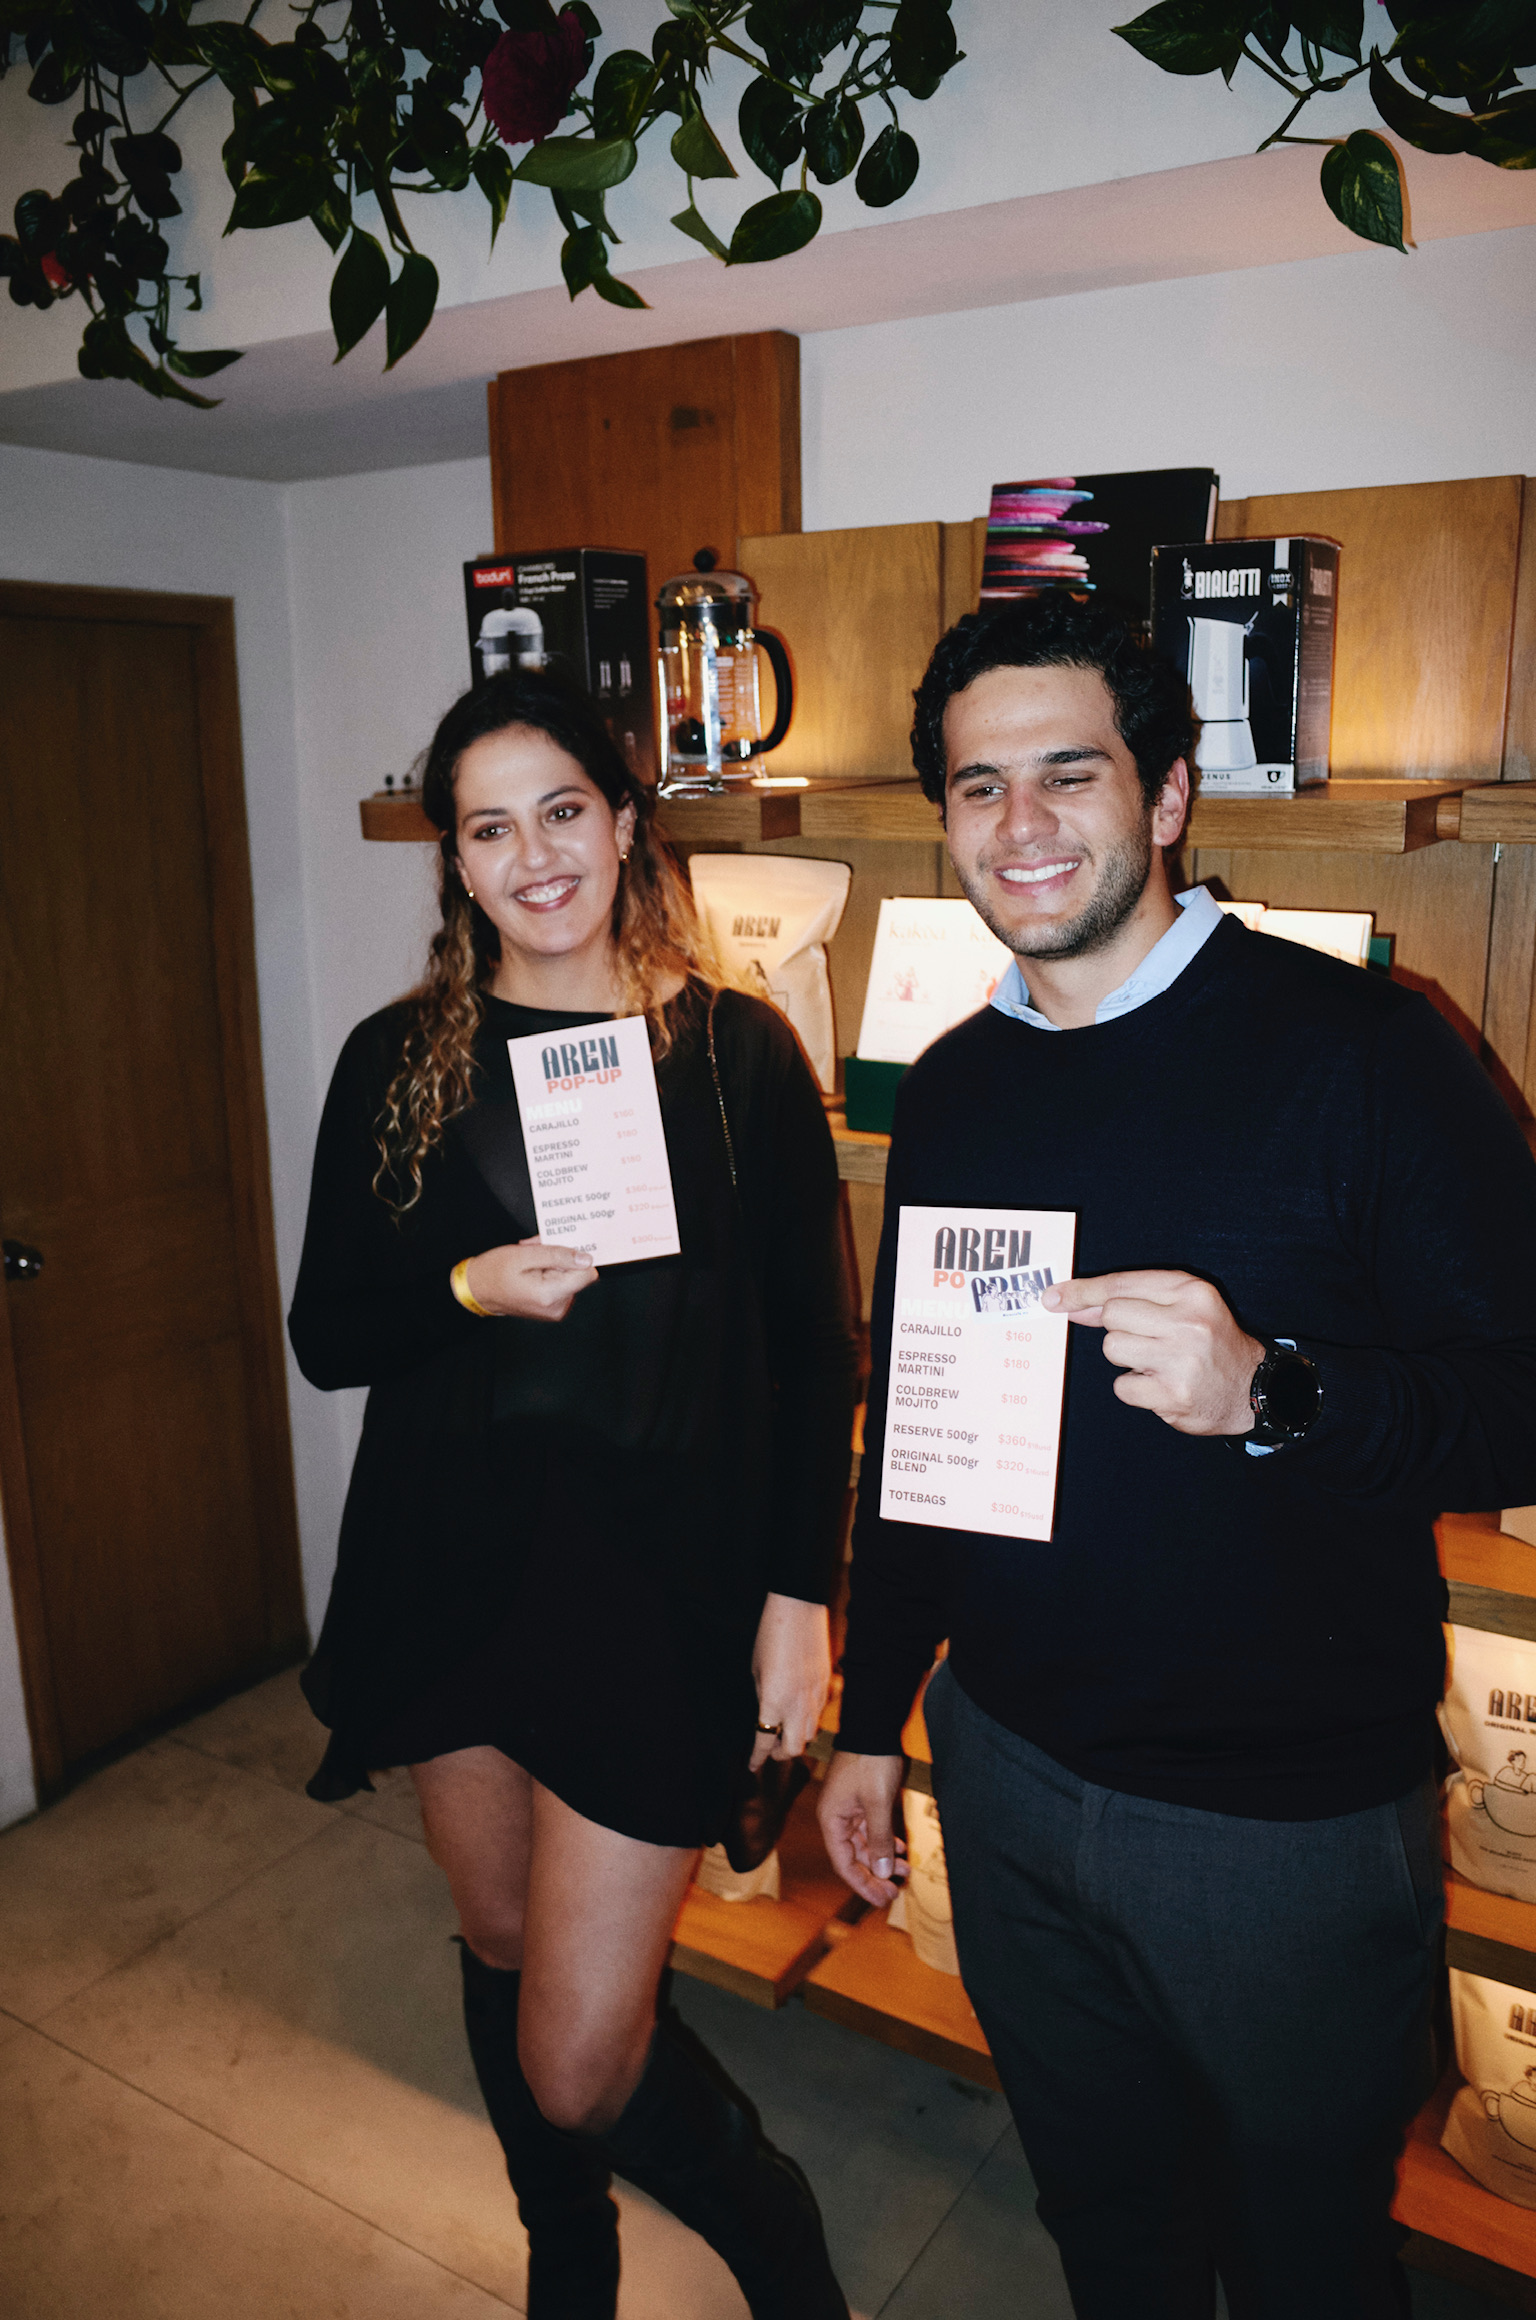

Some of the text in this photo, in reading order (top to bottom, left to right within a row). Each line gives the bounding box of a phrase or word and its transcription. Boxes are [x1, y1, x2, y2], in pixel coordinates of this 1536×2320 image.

[517, 570, 576, 585] French Press
[1195, 568, 1261, 599] BIALETTI
[1270, 573, 1291, 584] INOX
[732, 915, 781, 938] AREN
[541, 1034, 620, 1080] AREN
[546, 1068, 622, 1094] POP-UP
[525, 1098, 583, 1121] MENU
[529, 1118, 579, 1133] CARAJILLO
[532, 1139, 580, 1154] ESPRESSO
[534, 1151, 573, 1163] MARTINI
[537, 1164, 588, 1179] COLDBREW
[538, 1175, 574, 1188] MOJITO
[542, 1195, 583, 1208] RESERVE
[585, 1191, 611, 1202] 500gr
[544, 1213, 588, 1227] ORIGINAL
[590, 1209, 616, 1219] 500gr
[546, 1224, 577, 1236] BLEND
[933, 1226, 1032, 1271] AREN
[901, 1297, 971, 1320] MENU
[900, 1322, 962, 1337] CARAJILLO
[1005, 1330, 1032, 1342] $160
[898, 1350, 957, 1364] ESPRESSO
[1003, 1358, 1030, 1370] $180
[897, 1363, 945, 1377] MARTINI
[896, 1384, 960, 1400] COLDBREW
[1001, 1393, 1028, 1405] $180
[895, 1396, 939, 1410] MOJITO
[893, 1423, 979, 1444] RESERVE 500gr
[997, 1433, 1027, 1447] $360
[890, 1460, 927, 1473] BLEND
[891, 1448, 980, 1470] ORIGINAL 500gr
[996, 1459, 1024, 1472] $320
[889, 1489, 947, 1506] TOTEBAGS
[991, 1502, 1019, 1515] $300
[1488, 1688, 1536, 1723] ARE
[1508, 2003, 1536, 2037] AR
